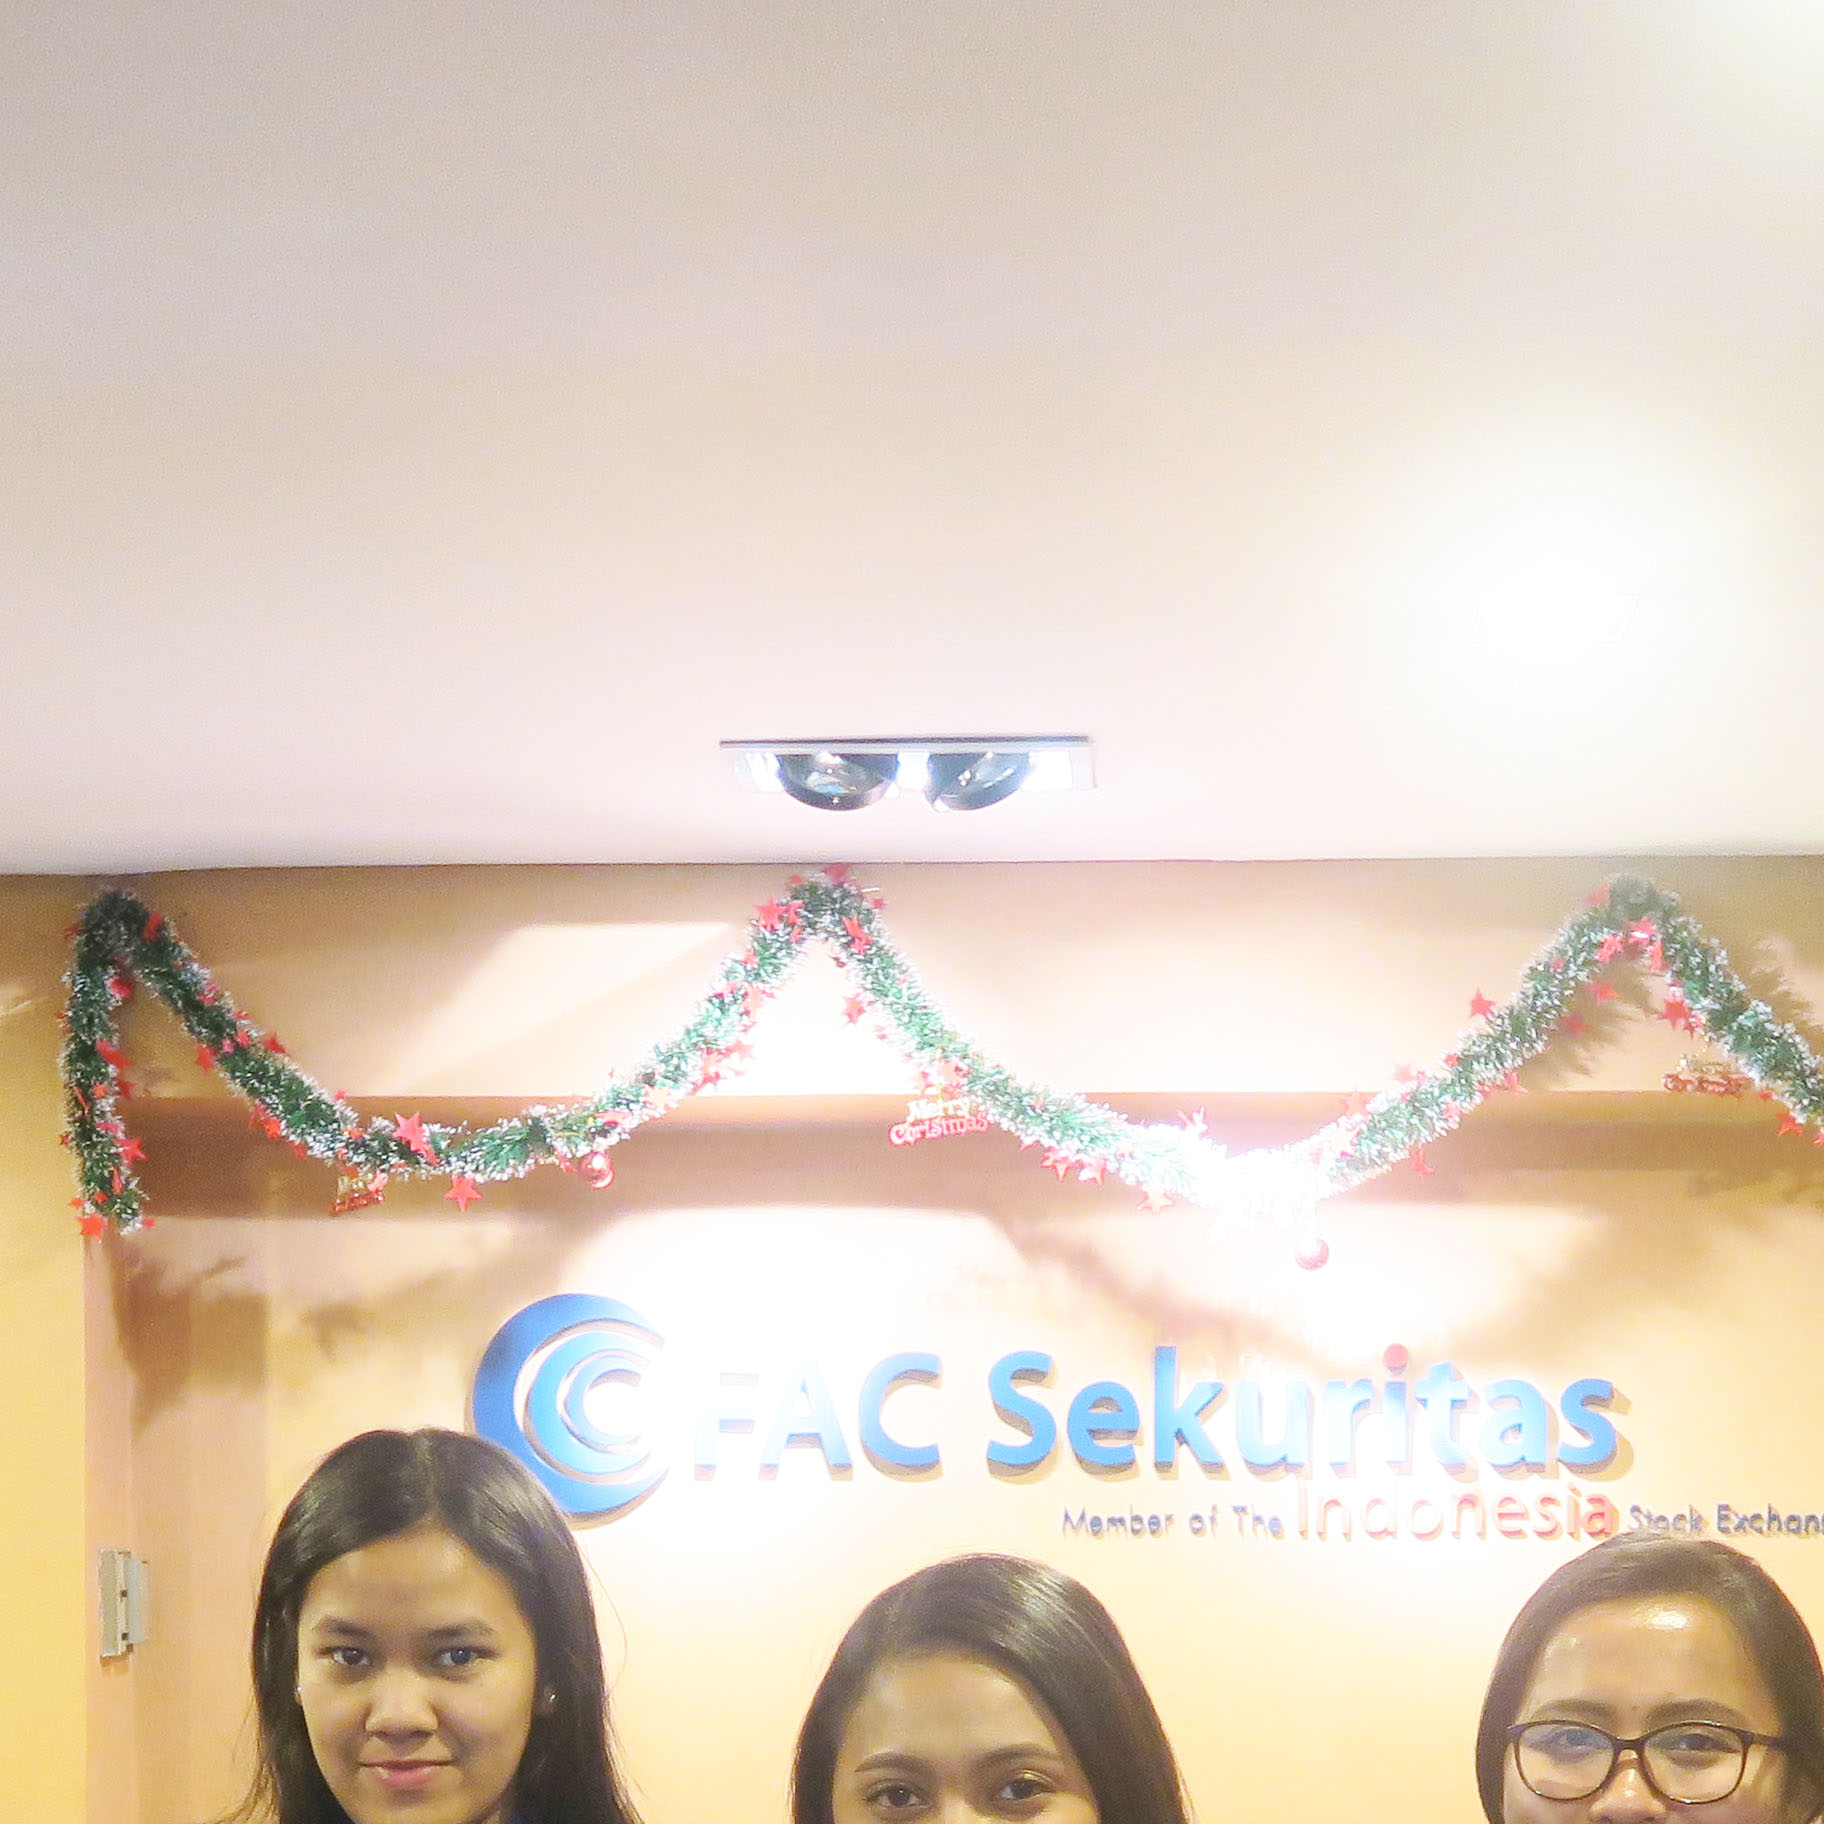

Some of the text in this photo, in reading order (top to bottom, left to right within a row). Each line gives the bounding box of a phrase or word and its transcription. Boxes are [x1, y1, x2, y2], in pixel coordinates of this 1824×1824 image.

[692, 1343, 1622, 1478] FAC Sekuritas
[1062, 1504, 1174, 1538] Member
[1188, 1504, 1219, 1538] of
[1232, 1504, 1285, 1539] The
[1297, 1477, 1618, 1539] Indonesia
[1627, 1503, 1706, 1533] Stock
